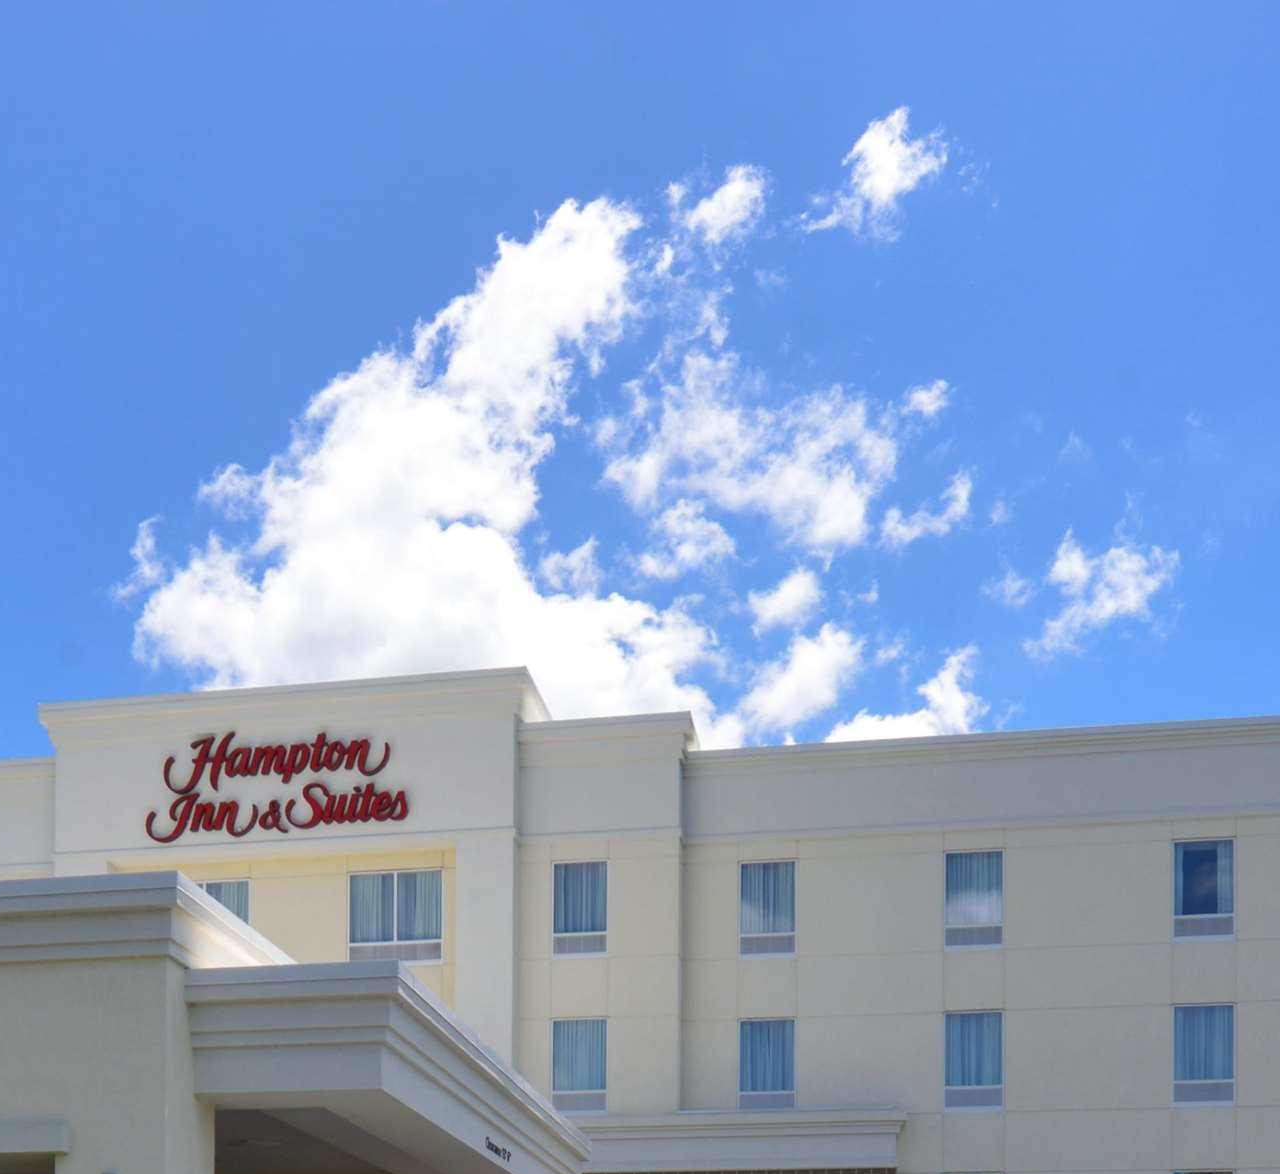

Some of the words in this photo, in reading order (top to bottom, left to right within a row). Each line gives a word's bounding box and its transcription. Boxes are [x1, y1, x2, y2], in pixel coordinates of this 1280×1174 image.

[163, 731, 391, 794] Hampton
[145, 793, 258, 843] Inn
[258, 800, 288, 833] &
[285, 783, 409, 829] Suites
